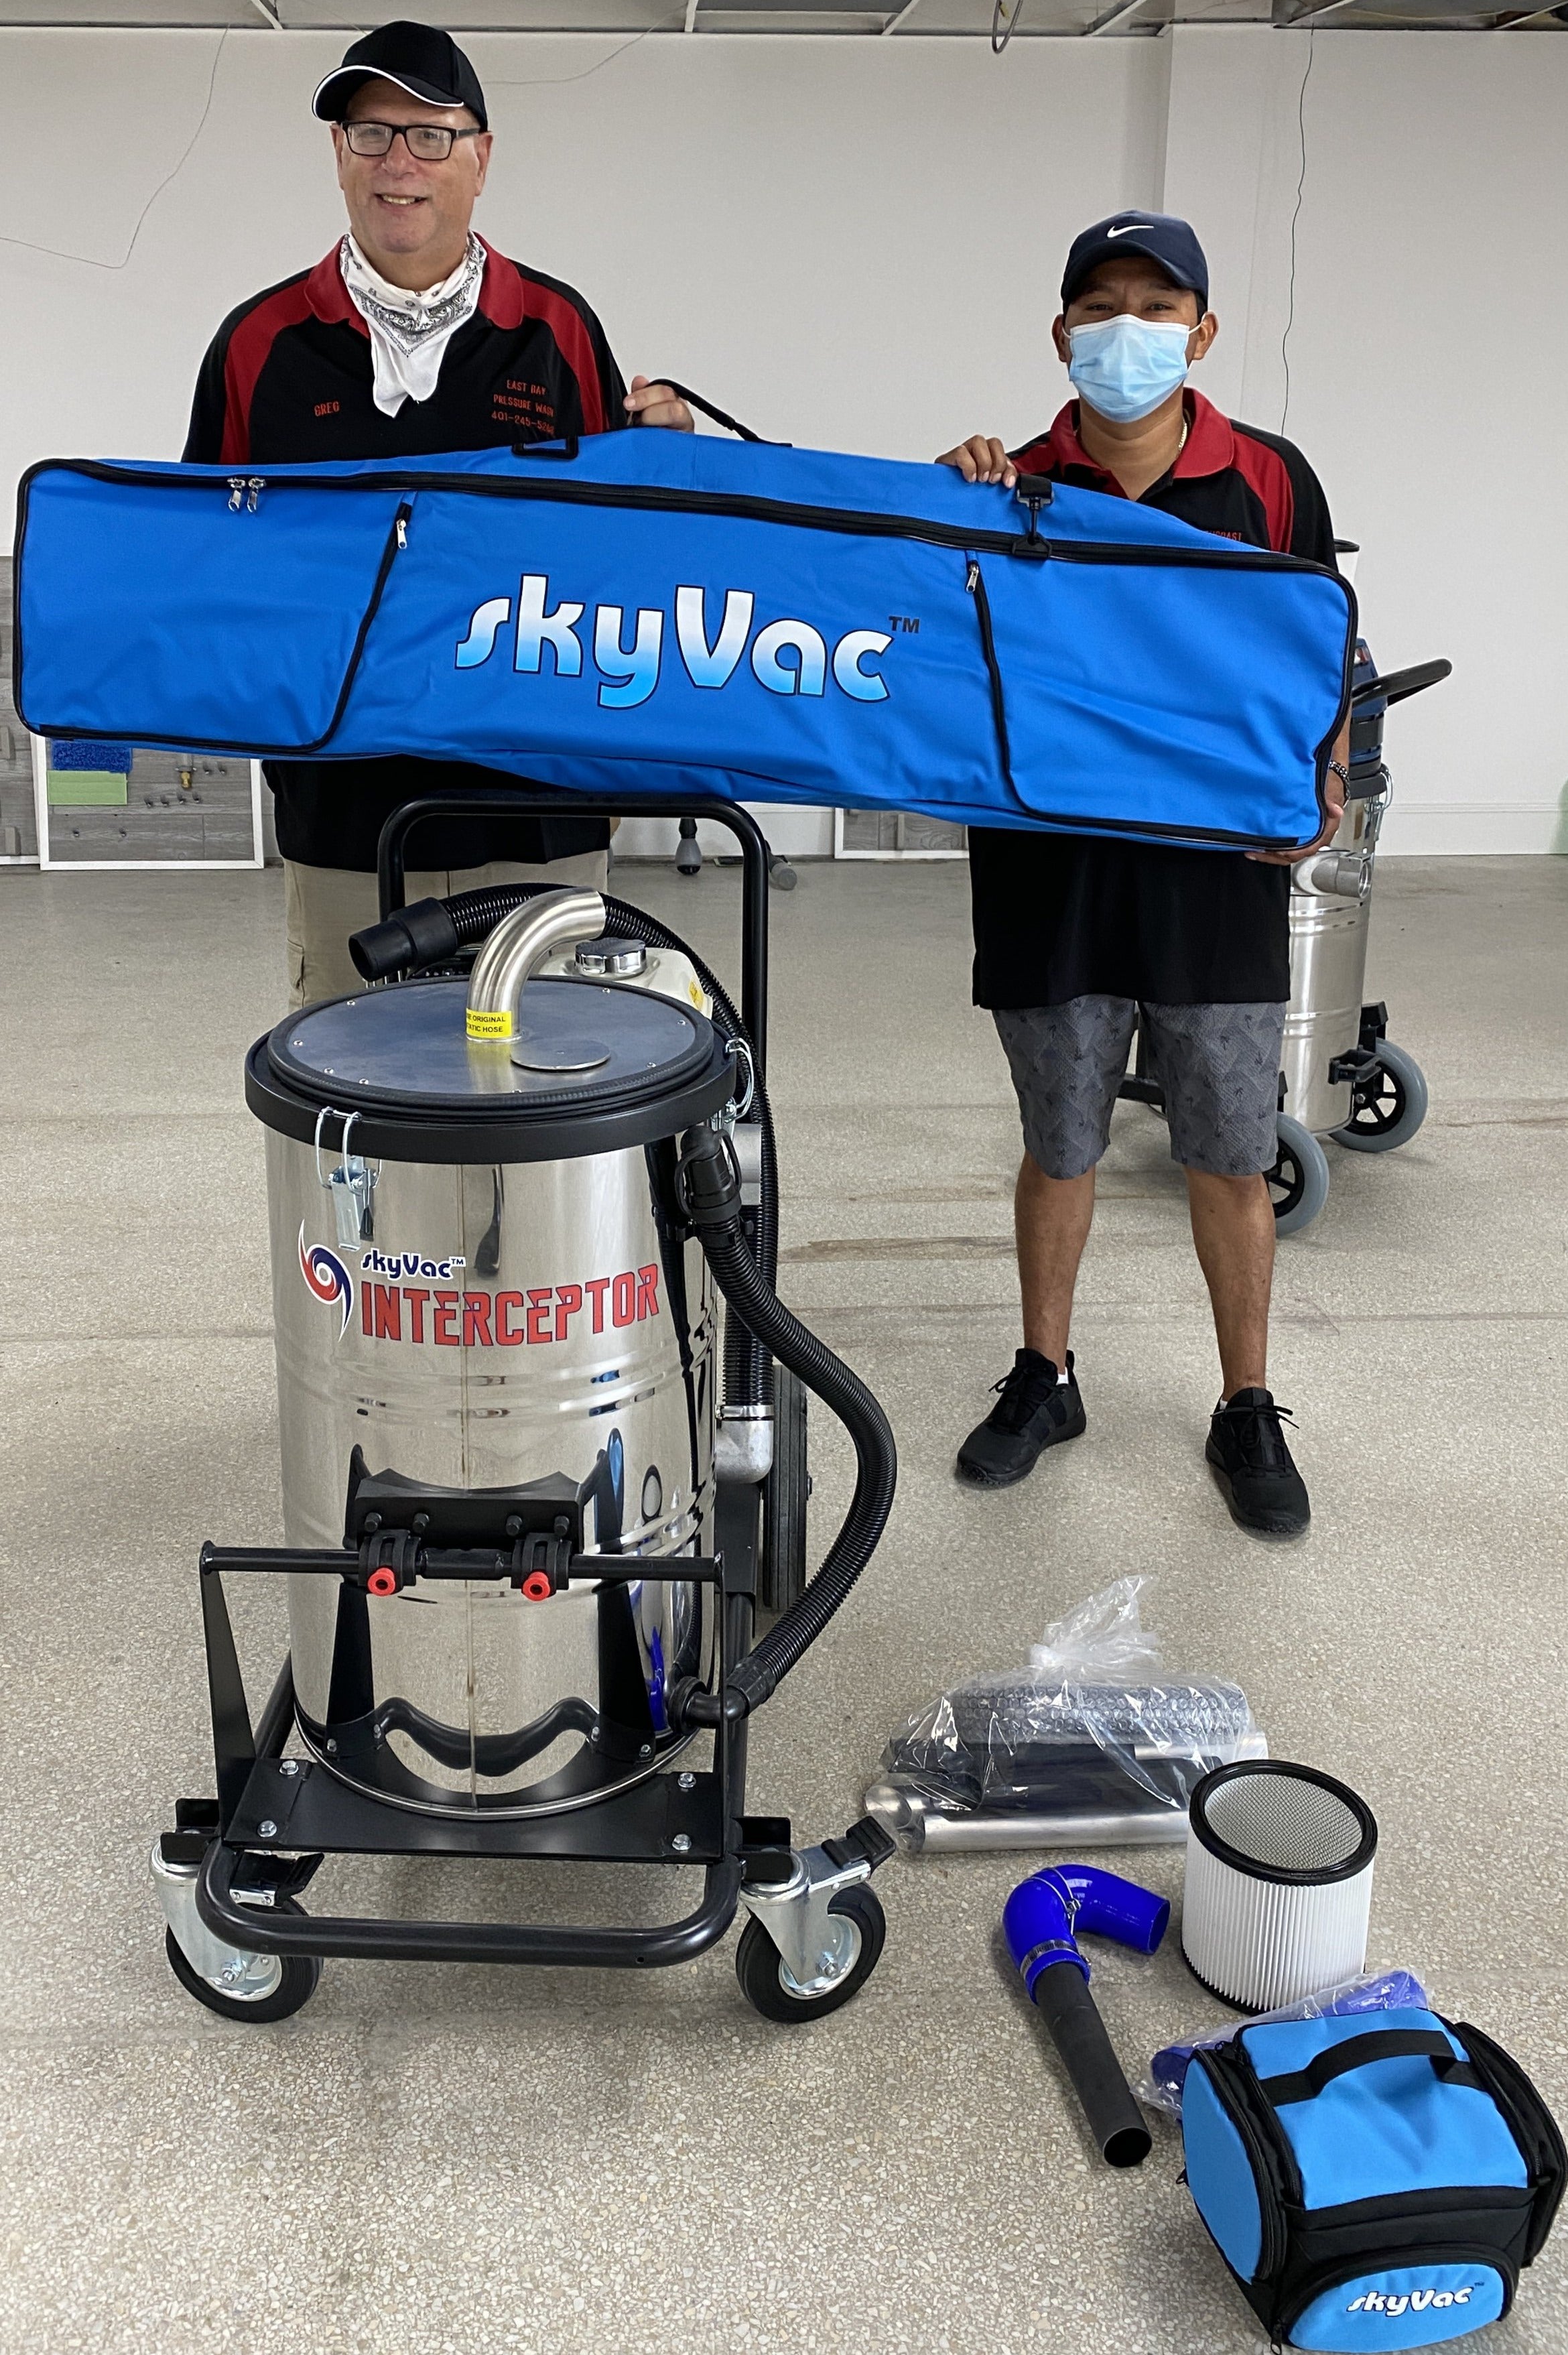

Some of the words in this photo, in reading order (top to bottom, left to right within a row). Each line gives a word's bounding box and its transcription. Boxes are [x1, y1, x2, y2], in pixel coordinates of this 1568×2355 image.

[507, 379, 527, 392] EAST
[314, 401, 340, 417] GREG
[493, 393, 531, 411] PRESSURE
[455, 574, 894, 710] skyVac
[361, 1249, 452, 1279] skyVac
[361, 1263, 659, 1346] INTERCEPTOR
[1346, 2286, 1474, 2317] skyVac
